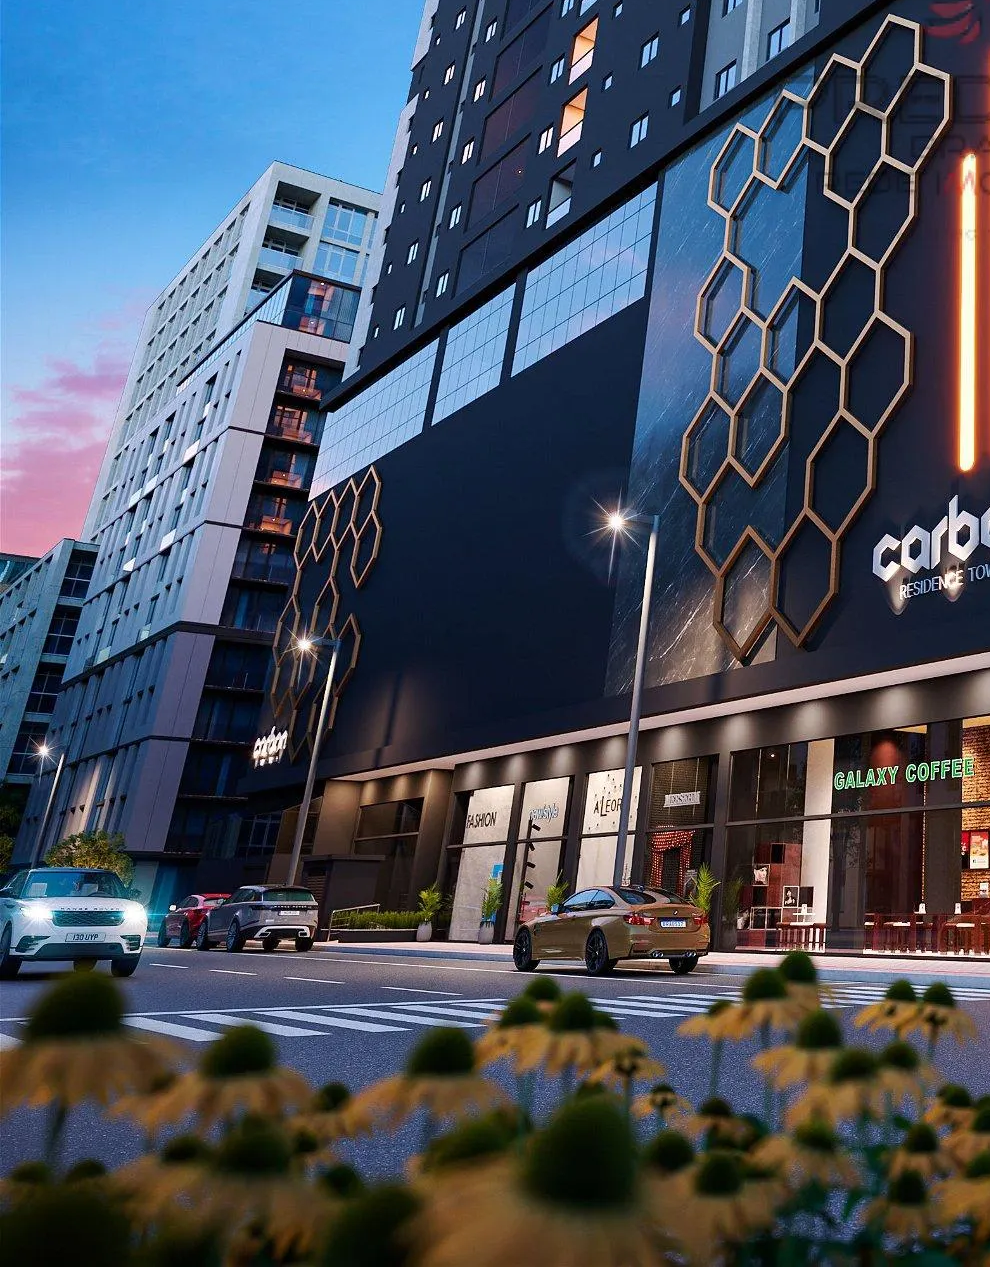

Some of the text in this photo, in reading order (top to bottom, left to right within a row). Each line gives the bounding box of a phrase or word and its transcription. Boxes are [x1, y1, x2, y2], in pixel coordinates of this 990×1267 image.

[900, 569, 965, 600] RESIDENCE
[834, 757, 975, 791] GALAXY COFFEE
[466, 812, 497, 829] FASHION
